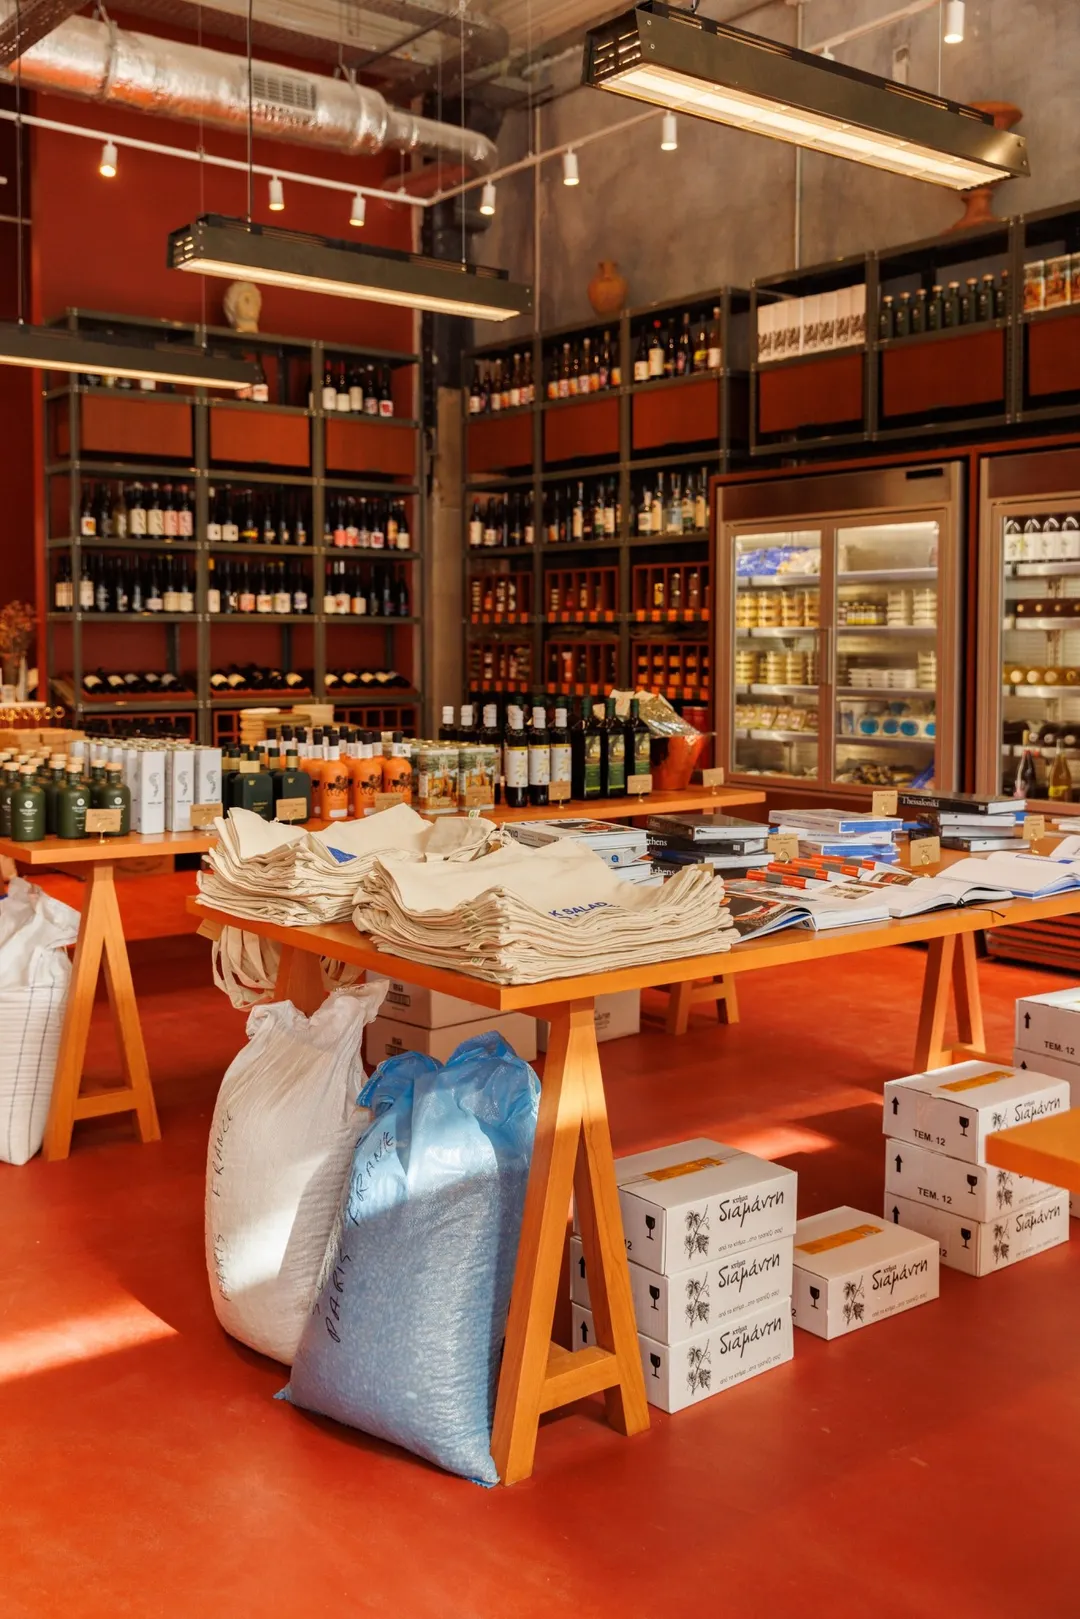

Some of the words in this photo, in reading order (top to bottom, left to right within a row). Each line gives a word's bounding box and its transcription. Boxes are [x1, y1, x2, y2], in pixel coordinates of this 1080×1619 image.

[901, 796, 939, 808] Thessaloniki
[646, 836, 668, 847] thens
[1065, 1046, 1076, 1056] 12
[935, 1136, 946, 1147] 12
[732, 1194, 748, 1205] κτήμα
[941, 1194, 953, 1205] 12
[719, 1191, 784, 1228] διαμάντη
[730, 1259, 746, 1270] κτήμα
[718, 1253, 780, 1293] διαμάντη
[872, 1258, 928, 1295] διαμάντη
[325, 1248, 352, 1343] PARIS
[732, 1324, 748, 1336] κτήμα
[720, 1317, 782, 1359] διαμάντη
